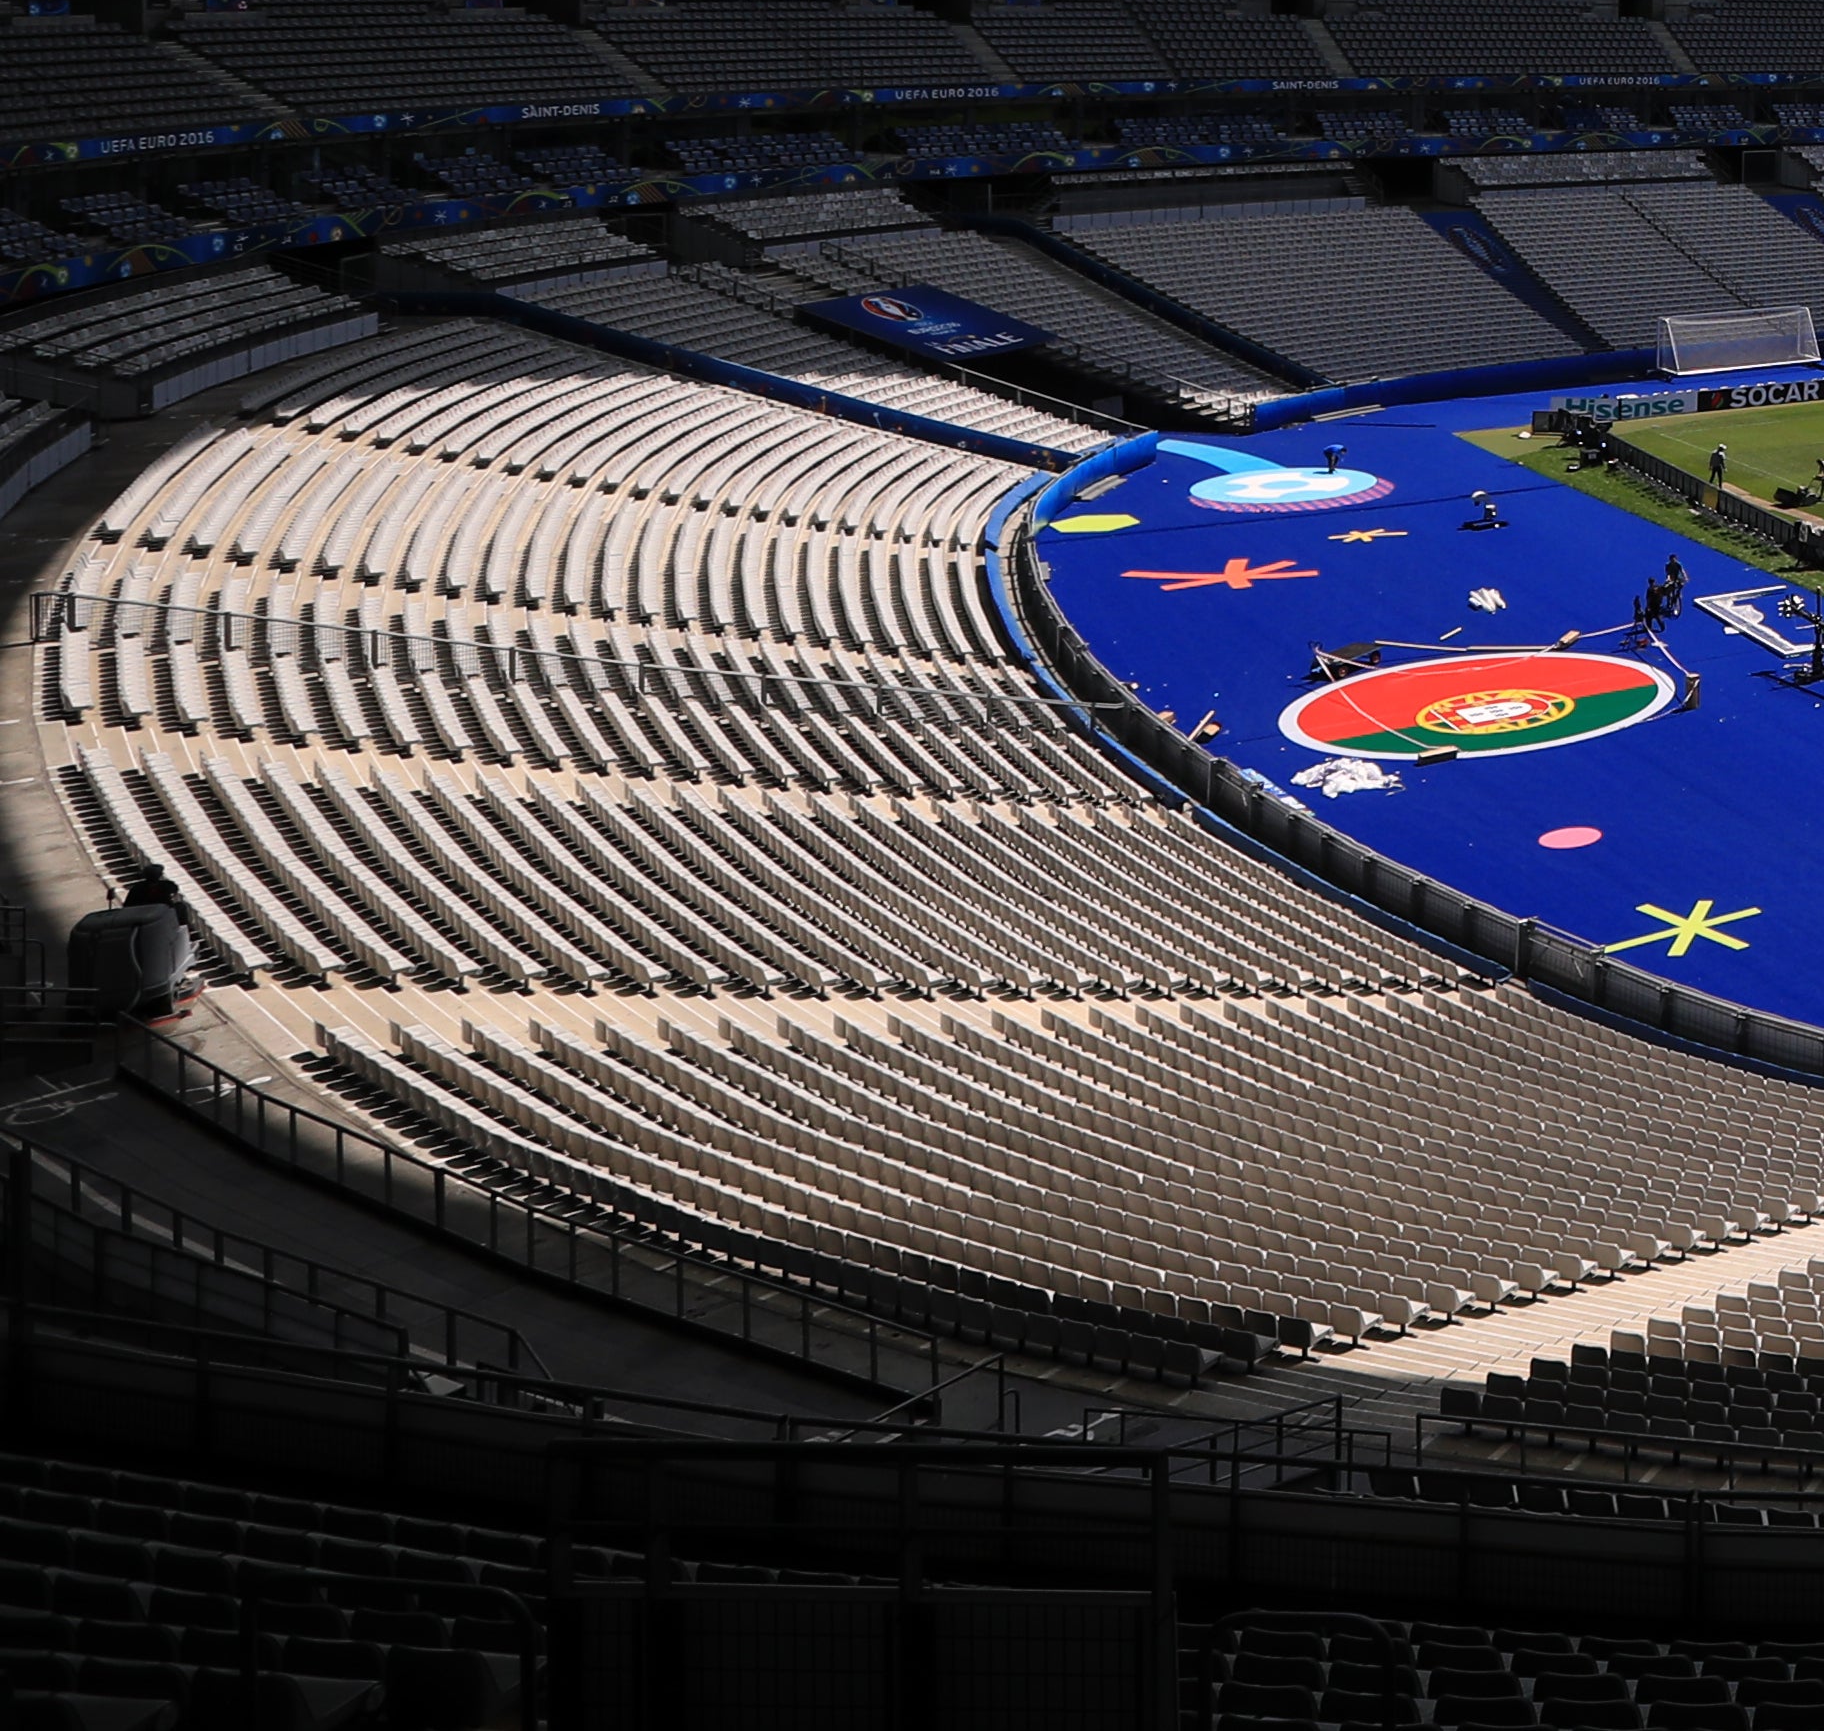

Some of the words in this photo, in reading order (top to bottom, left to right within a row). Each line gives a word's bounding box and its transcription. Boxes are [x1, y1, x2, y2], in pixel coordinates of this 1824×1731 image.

[1606, 76, 1633, 85] EURO
[894, 88, 927, 100] UEFA
[929, 87, 965, 99] EURO
[966, 86, 999, 98] 2016
[521, 103, 600, 118] SAINT-DENIS
[100, 138, 136, 152] UEFA
[139, 134, 177, 149] EURO
[178, 131, 214, 145] 2016
[934, 331, 1024, 355] FINALE
[1729, 381, 1820, 409] SOCAR
